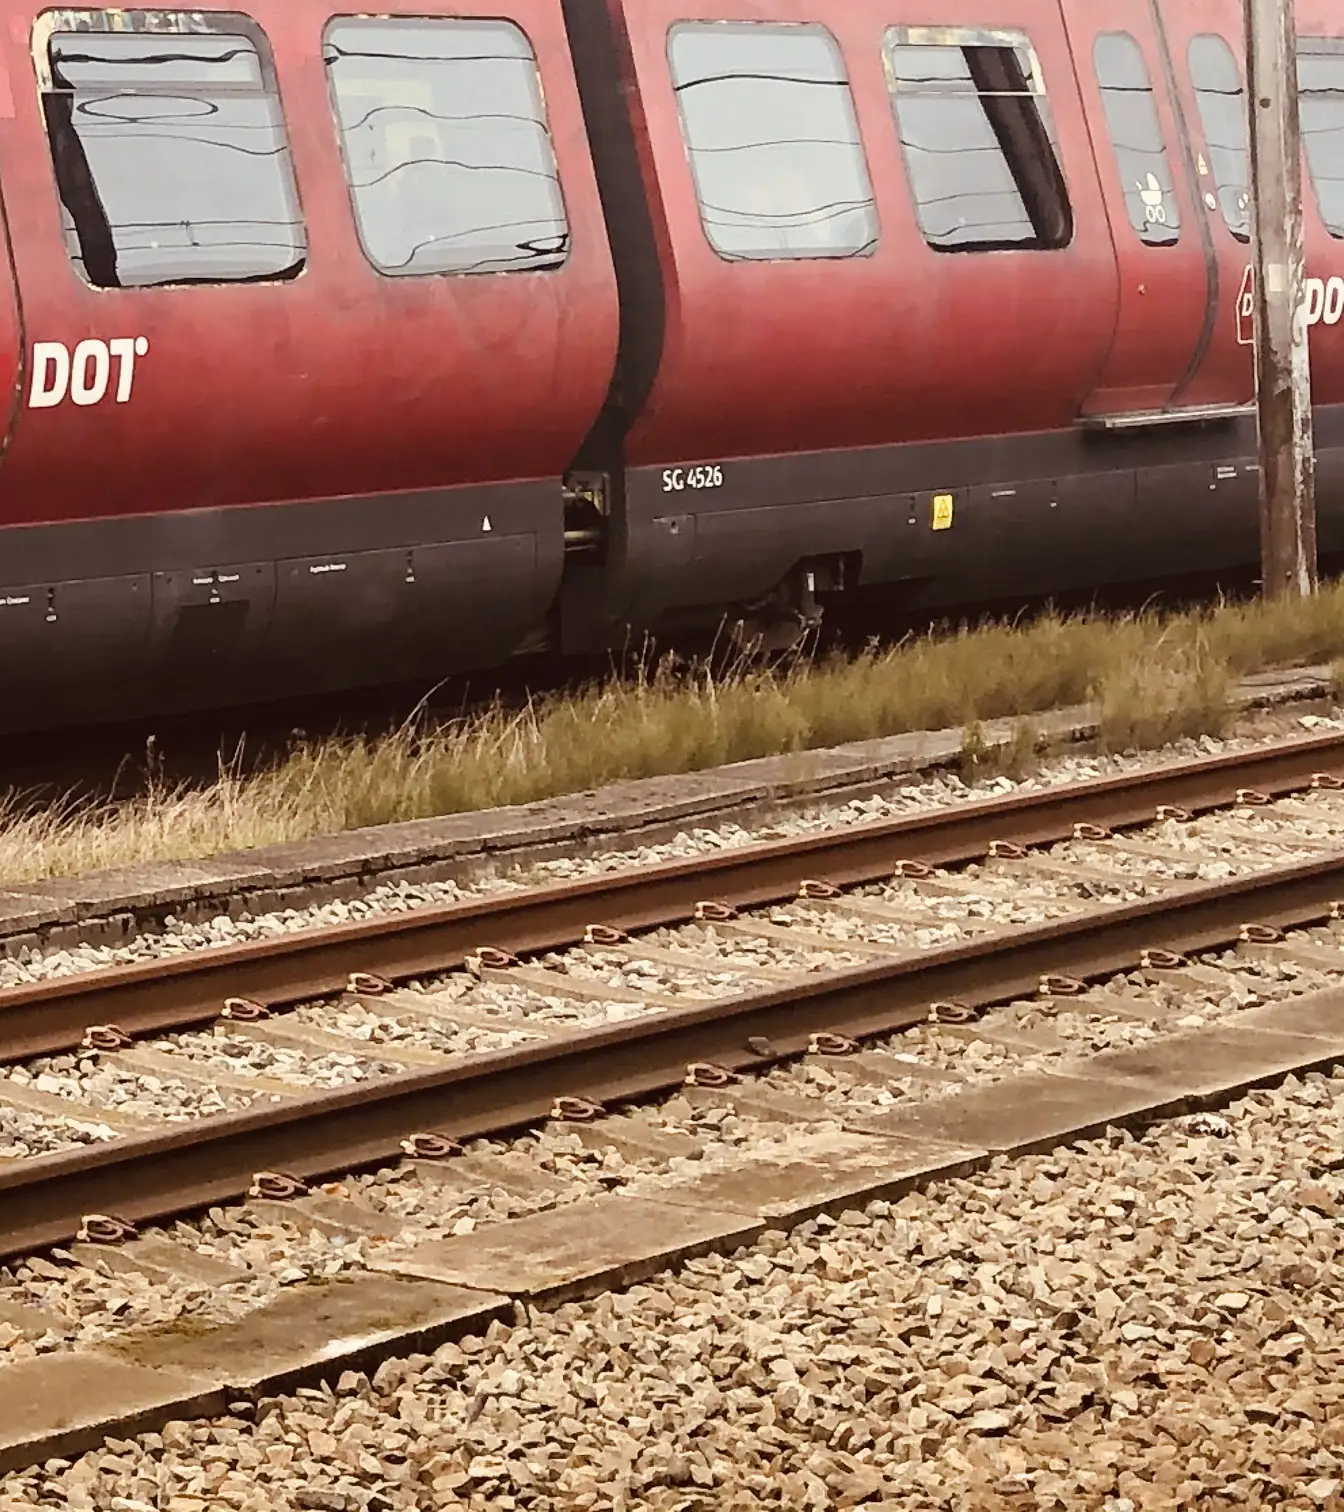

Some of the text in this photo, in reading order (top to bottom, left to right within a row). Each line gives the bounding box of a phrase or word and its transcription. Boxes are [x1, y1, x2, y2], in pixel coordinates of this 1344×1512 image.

[1305, 276, 1344, 325] DO
[28, 336, 149, 408] DOT
[662, 465, 723, 492] SG 4526
